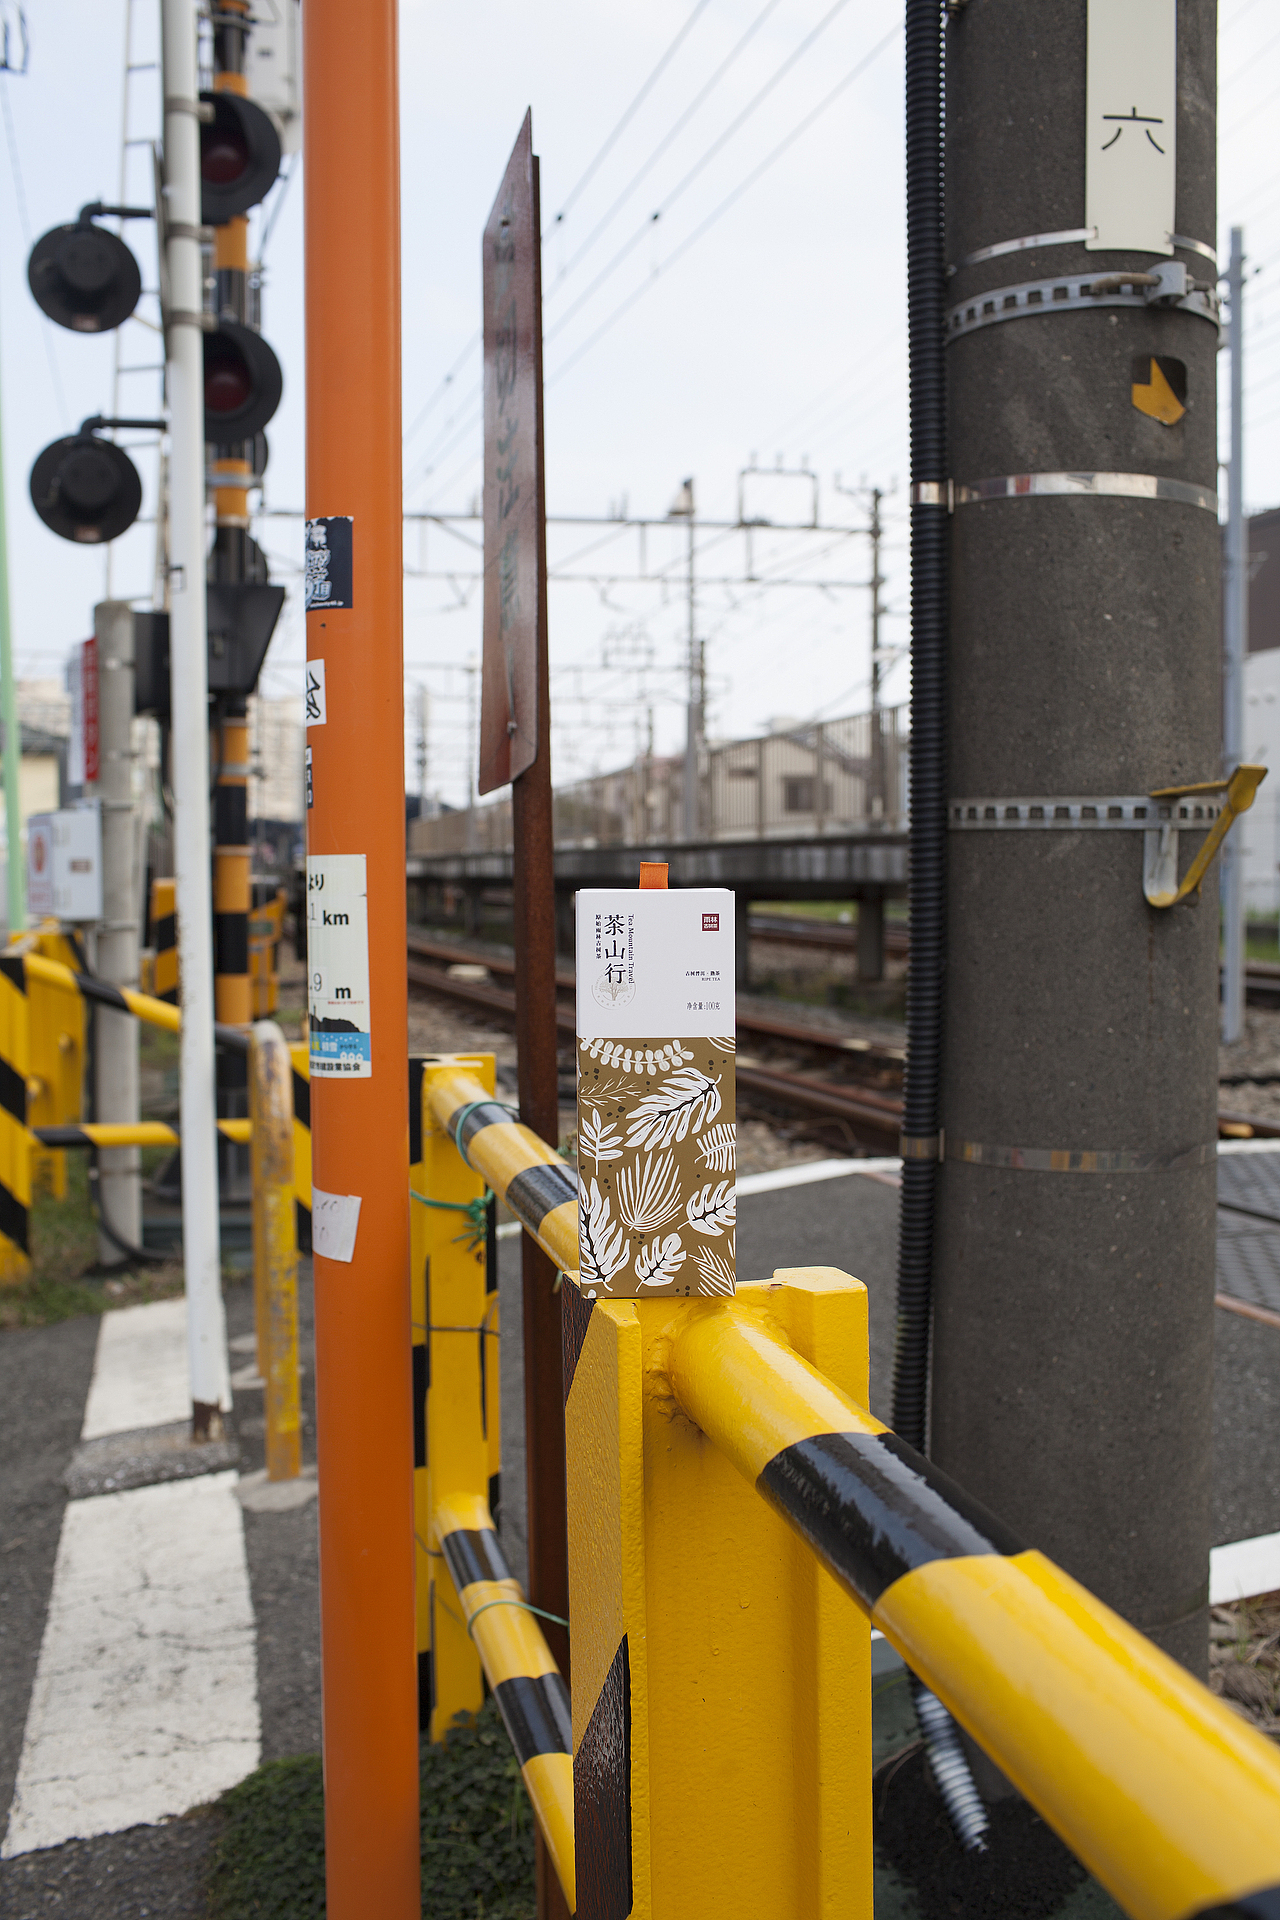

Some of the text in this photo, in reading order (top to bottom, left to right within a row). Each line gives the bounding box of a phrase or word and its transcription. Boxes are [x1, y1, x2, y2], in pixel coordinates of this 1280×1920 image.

[1101, 106, 1165, 154] 六
[322, 910, 349, 925] km
[604, 914, 626, 984] 茶山行
[335, 987, 351, 999] m
